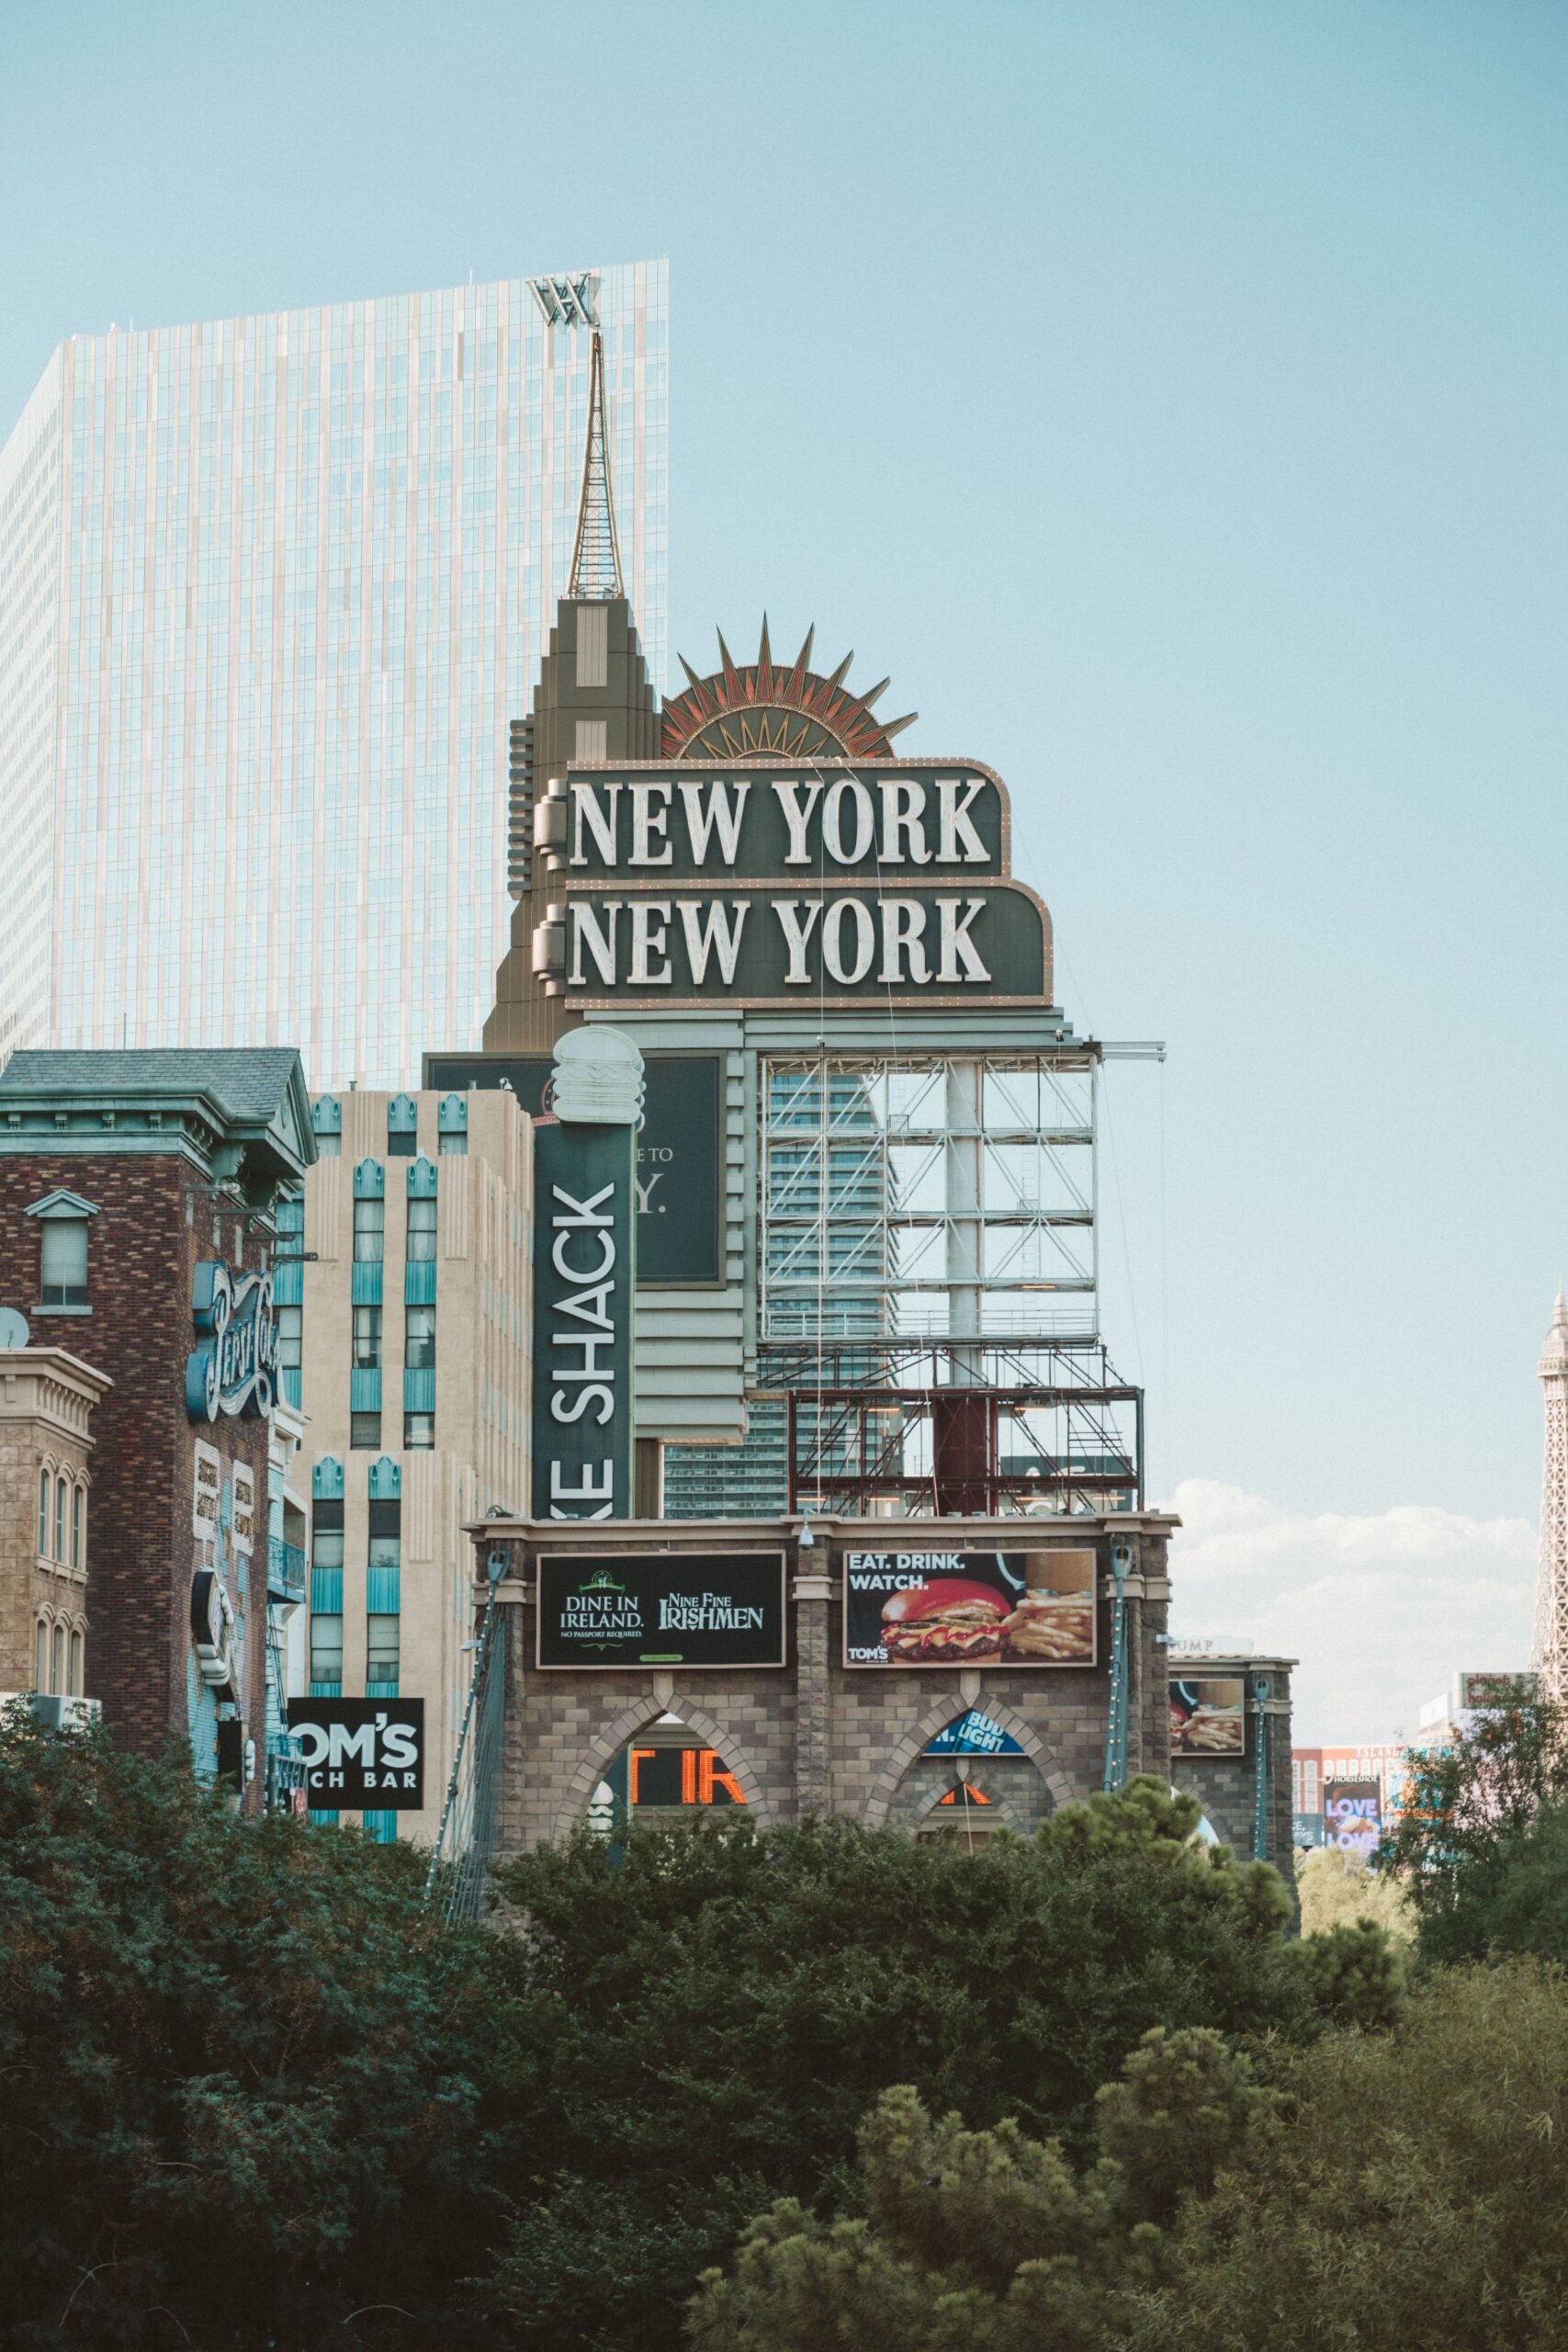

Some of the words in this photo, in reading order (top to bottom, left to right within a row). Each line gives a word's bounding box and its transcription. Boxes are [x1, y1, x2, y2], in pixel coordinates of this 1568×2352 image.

[569, 781, 751, 867] NEW
[771, 778, 991, 866] YORK
[567, 899, 751, 986] NEW
[771, 896, 992, 985] YORK
[648, 1148, 673, 1162] TO
[550, 1182, 616, 1425] SHACK
[849, 1554, 890, 1569] EAT.
[897, 1554, 965, 1569] DRINK.
[849, 1574, 929, 1590] WATCH.
[565, 1596, 612, 1611] DINE
[616, 1596, 638, 1611] IN
[668, 1592, 699, 1608] NINE
[702, 1592, 731, 1608] FINE
[559, 1612, 644, 1628] IRELAND.
[658, 1599, 763, 1630] IRISHMEN
[848, 1645, 888, 1659] TOM'S
[967, 1711, 1006, 1737] BUD
[958, 1724, 1005, 1752] LIGHT
[363, 1771, 417, 1789] BAR
[1325, 1798, 1378, 1817] LOVE
